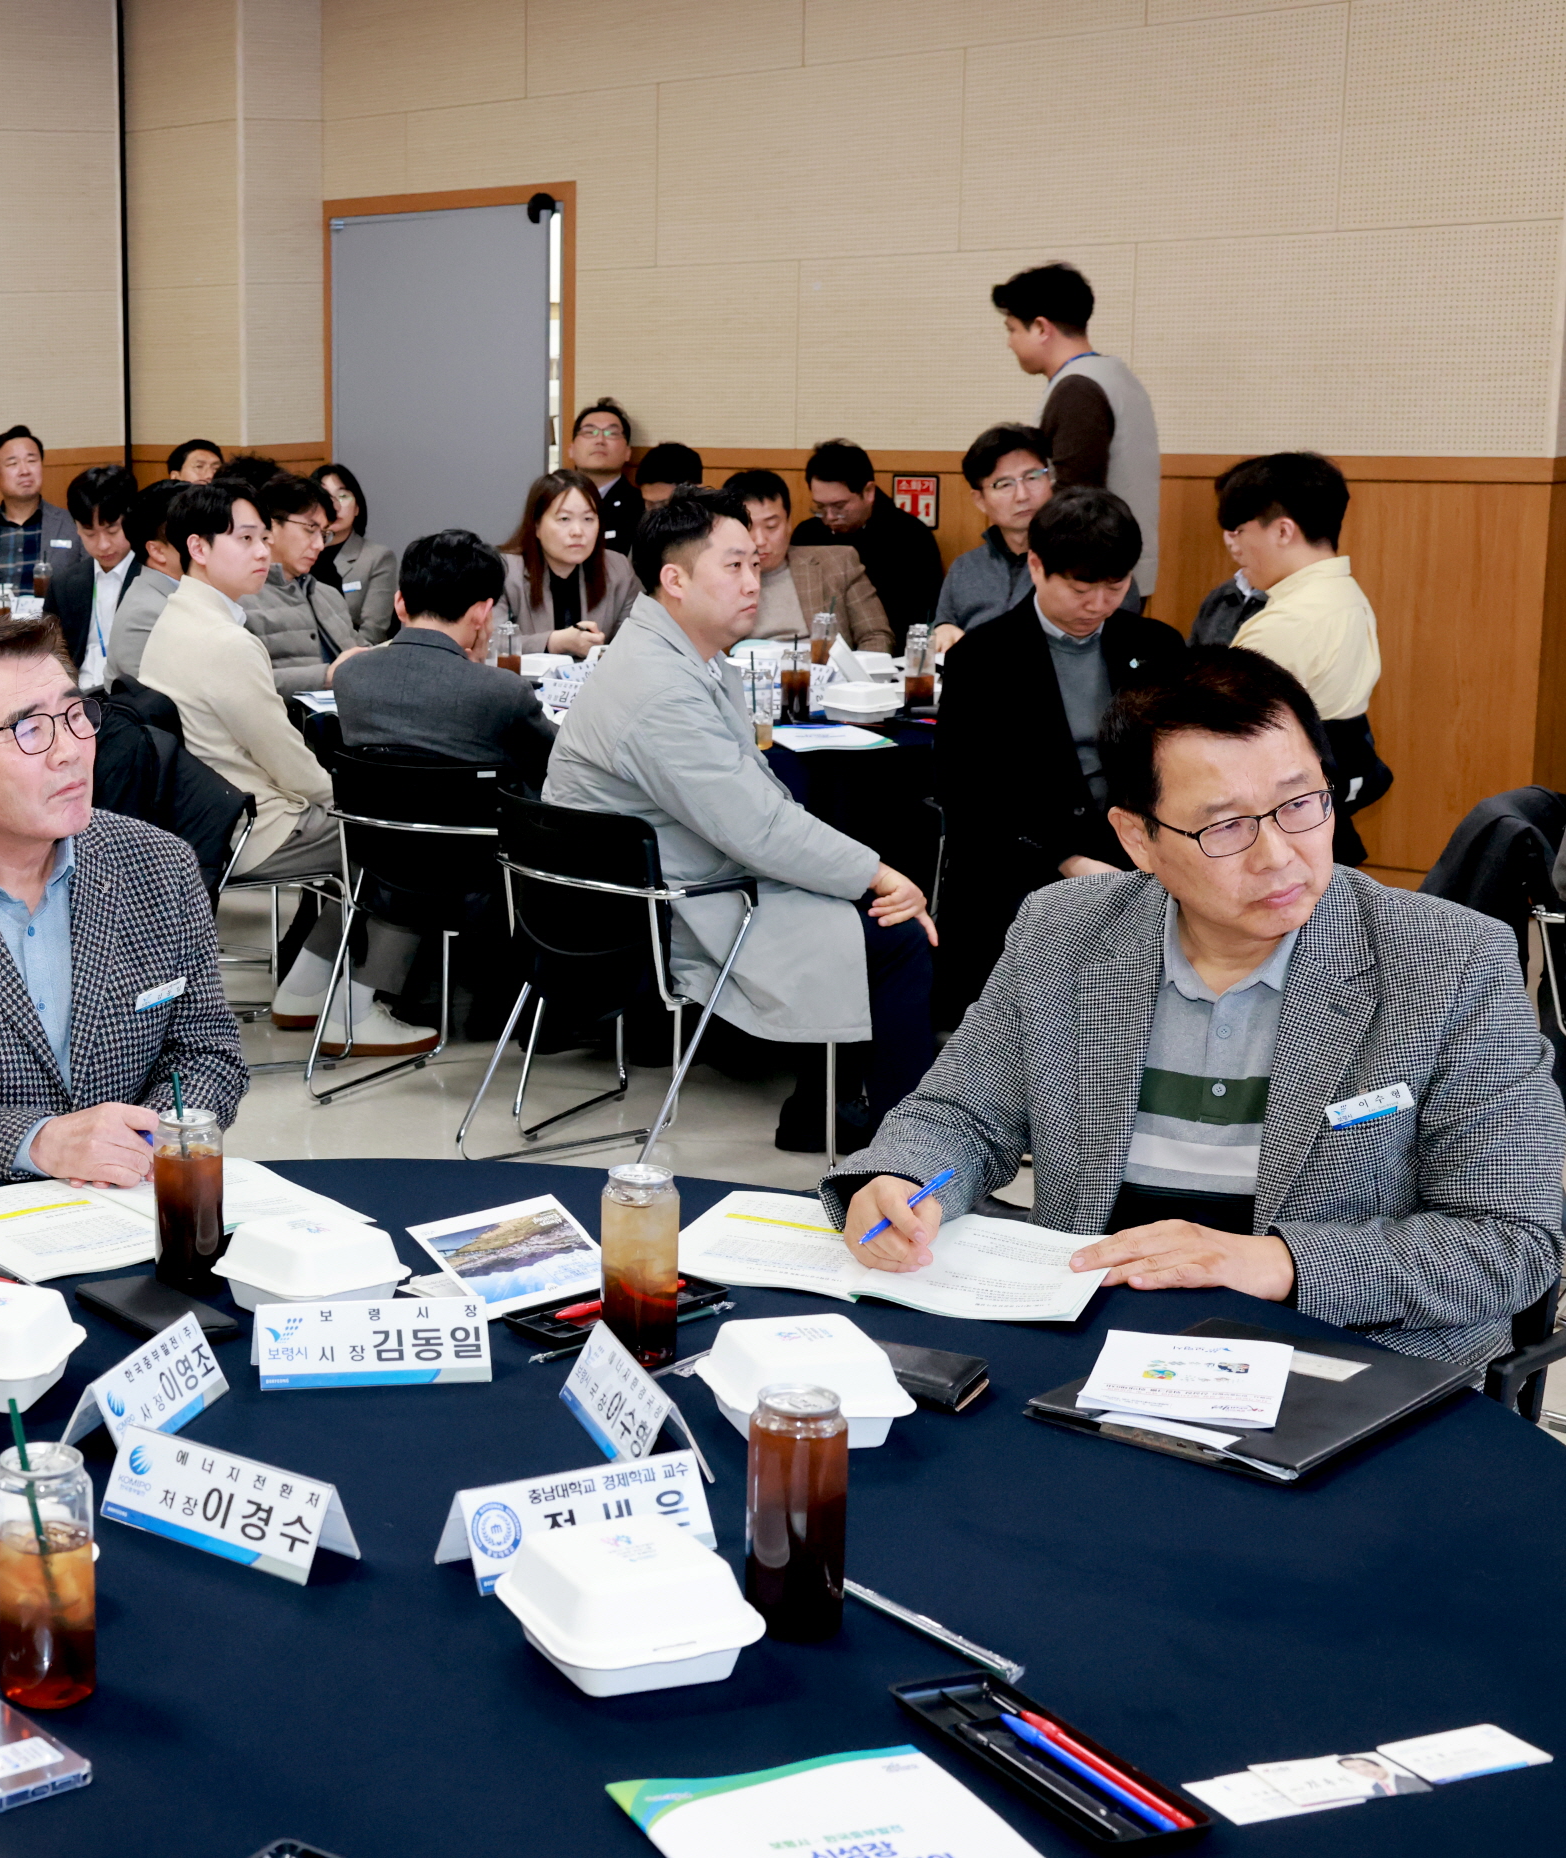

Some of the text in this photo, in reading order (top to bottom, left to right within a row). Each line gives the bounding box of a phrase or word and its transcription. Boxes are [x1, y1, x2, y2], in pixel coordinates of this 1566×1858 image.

[898, 481, 934, 492] 소화기
[1358, 1088, 1401, 1108] 이수형
[268, 1346, 308, 1361] 보령시
[372, 1326, 483, 1362] 김동일
[159, 1343, 216, 1402] 이영조
[606, 1390, 653, 1458] 이수형
[118, 1474, 152, 1492] KOMIPO
[176, 1449, 321, 1508] 에너지전환처
[528, 1461, 690, 1505] 충남대학교 경제학과 교수
[202, 1487, 313, 1553] 이경수
